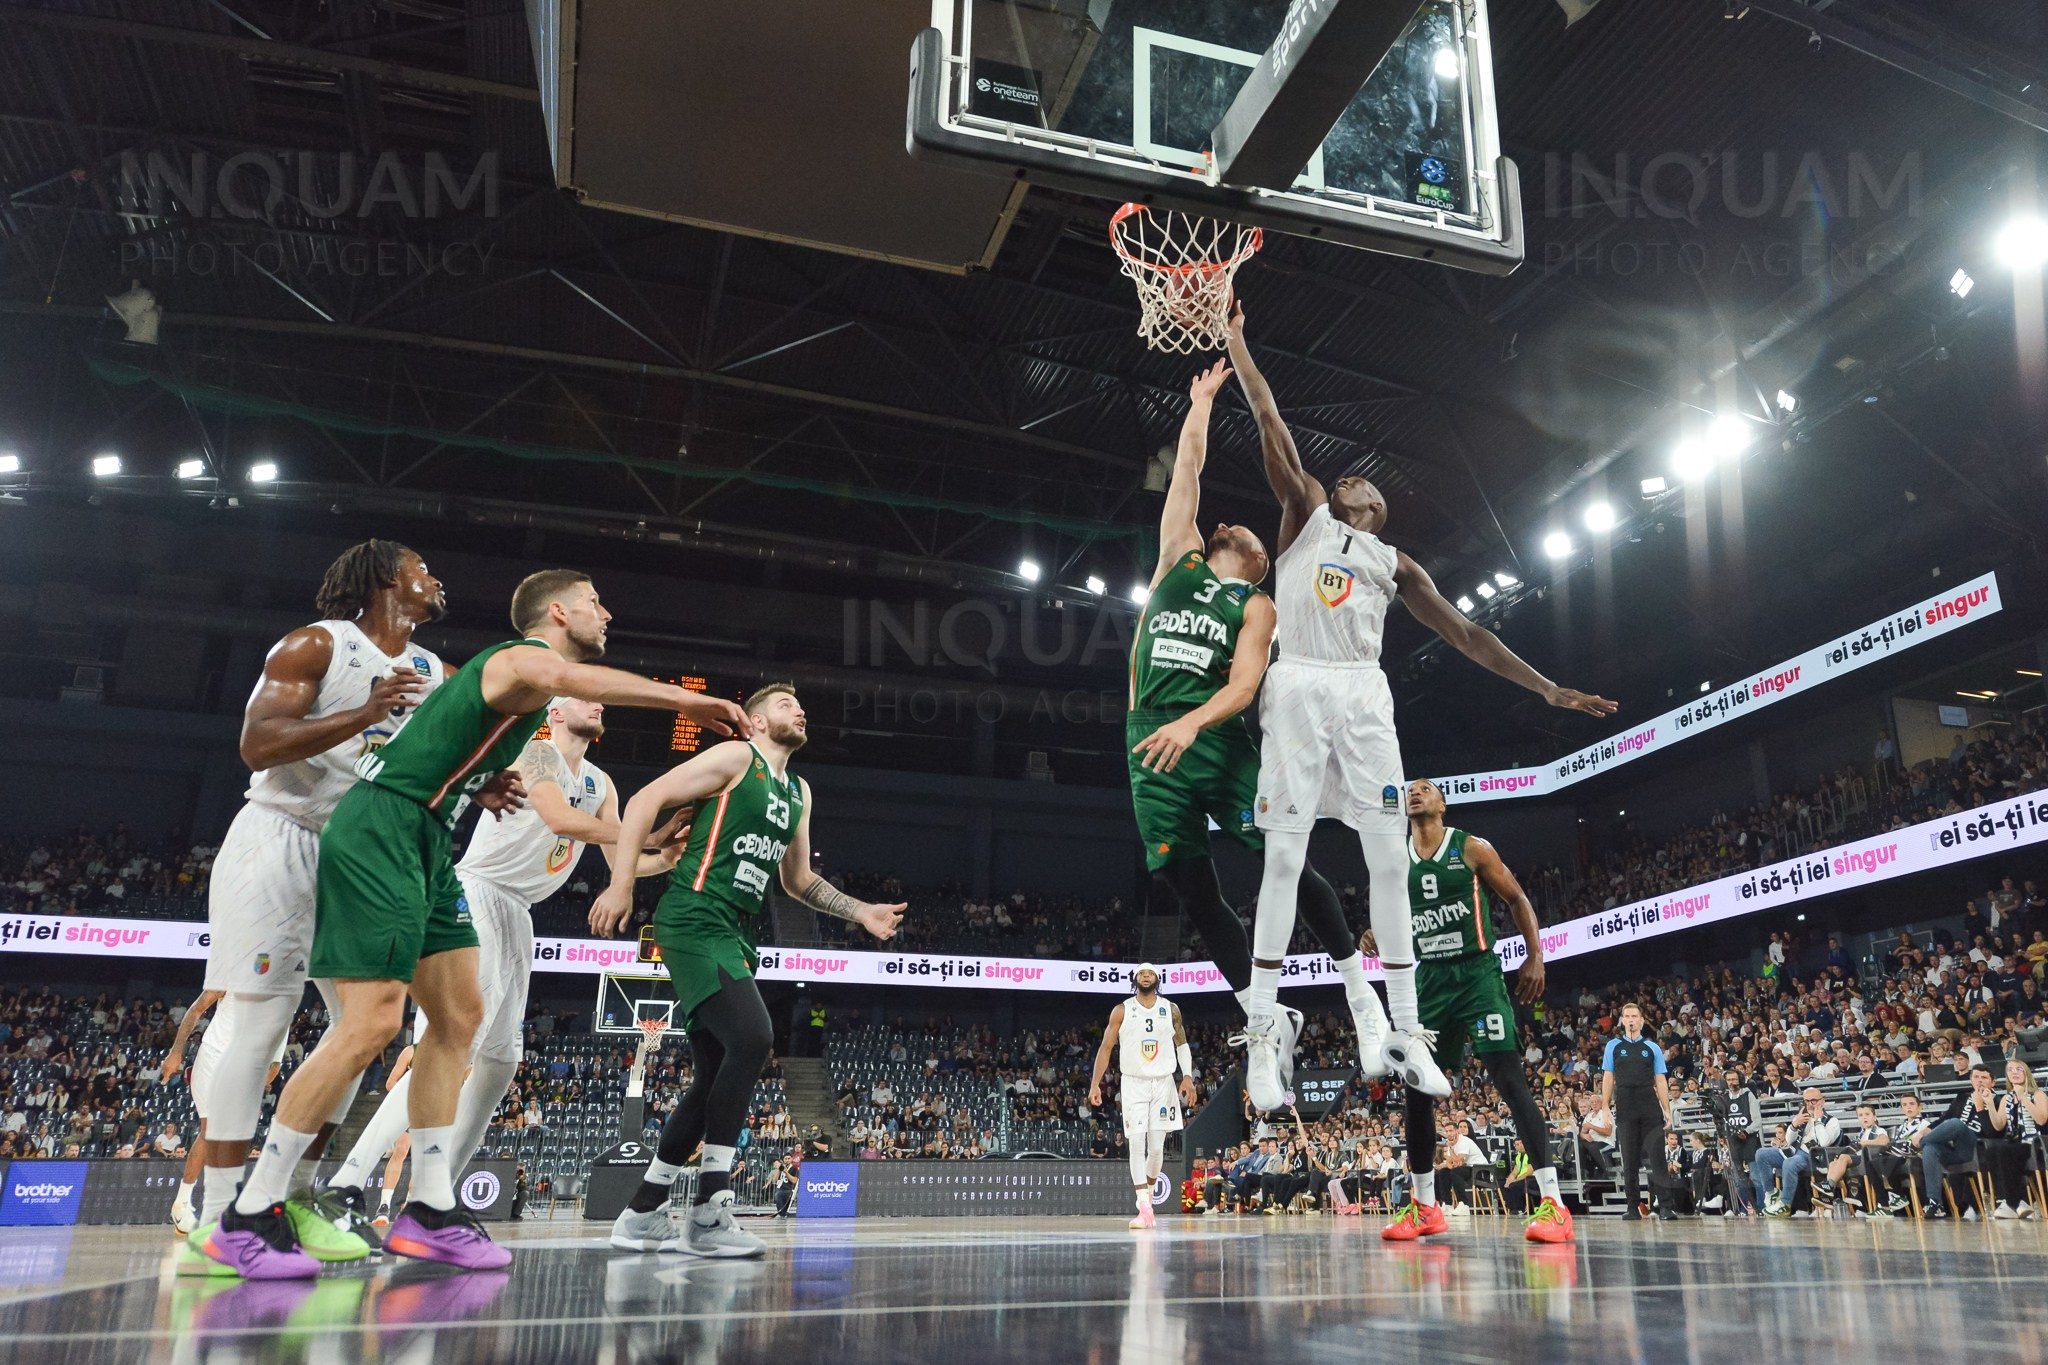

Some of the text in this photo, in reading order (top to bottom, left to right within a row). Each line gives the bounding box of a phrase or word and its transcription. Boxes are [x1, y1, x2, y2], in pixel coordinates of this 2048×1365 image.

[993, 86, 1039, 102] oneteam
[1416, 195, 1455, 210] EuroCup
[1341, 534, 1353, 555] 1
[1193, 578, 1221, 603] 3
[1323, 572, 1346, 590] BT
[1148, 610, 1228, 645] CEDEVITA
[1825, 641, 1849, 667] rei
[1898, 610, 1922, 637] iei
[1925, 585, 1989, 625] singur
[1158, 644, 1205, 661] PETROL
[1674, 708, 1693, 731] rei
[1731, 684, 1750, 707] iei
[1752, 664, 1801, 698] singur
[1555, 760, 1570, 780] rei
[1601, 742, 1616, 761] iei
[1617, 728, 1656, 754] singur
[1454, 778, 1476, 794] iei
[1479, 774, 1537, 792] singur
[765, 792, 790, 830] 23
[1930, 821, 1962, 850] rei
[1735, 877, 1757, 901] rei
[1806, 856, 1831, 882] iei
[1833, 843, 1898, 875] singur
[1421, 873, 1439, 900] 9
[1587, 918, 1604, 939] rei
[1641, 902, 1661, 925] iei
[1663, 893, 1711, 919] singur
[26, 920, 61, 940] iei
[65, 922, 150, 948] singur
[534, 942, 637, 966] iei singur
[784, 953, 849, 975] singur
[877, 955, 1043, 982] rei să-ți iei singur
[1070, 965, 1095, 983] rei
[1145, 1018, 1154, 1033] 3
[1486, 1014, 1505, 1041] 9
[1144, 1044, 1156, 1052] BT
[1302, 1080, 1345, 1089] 29 SEP
[1303, 1091, 1338, 1102] 19:0
[1169, 1106, 1176, 1121] 3
[14, 1183, 74, 1197] brother
[472, 1182, 490, 1201] U
[807, 1181, 850, 1193] brother
